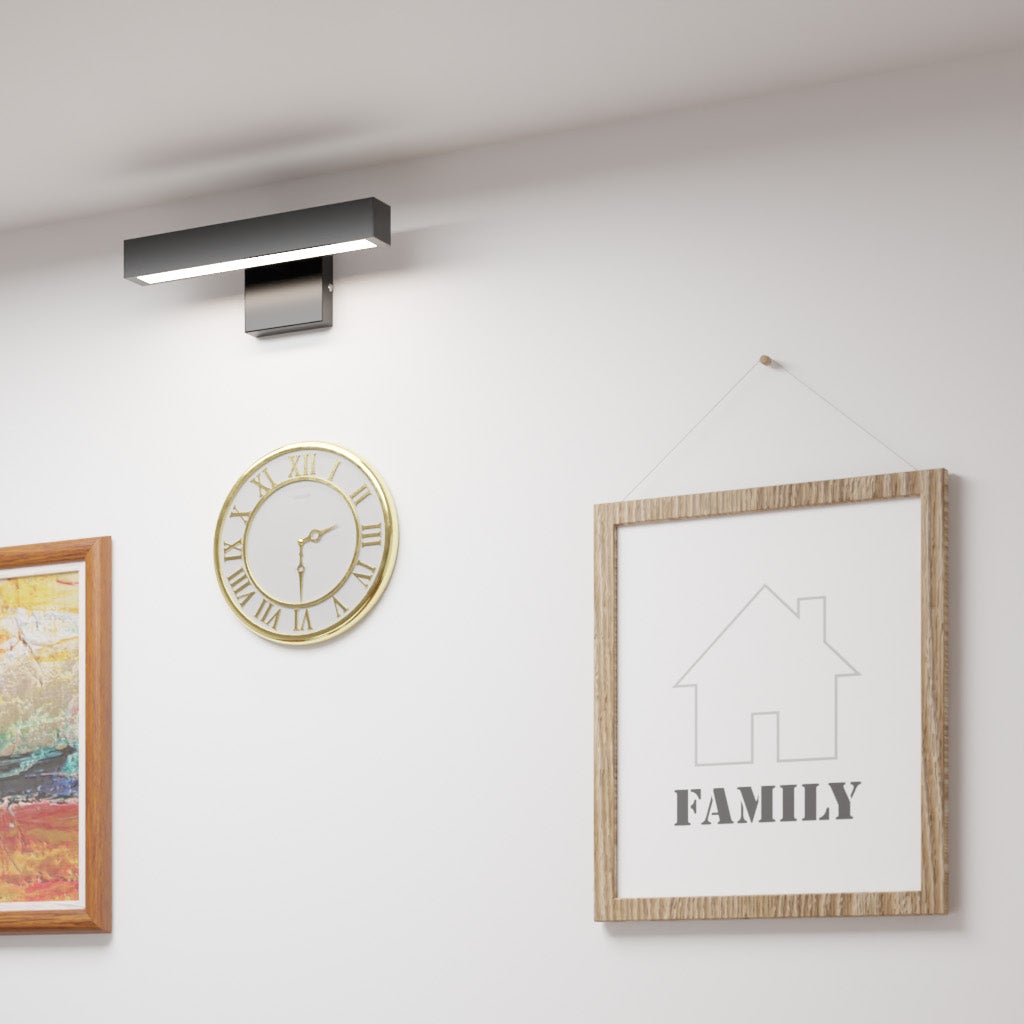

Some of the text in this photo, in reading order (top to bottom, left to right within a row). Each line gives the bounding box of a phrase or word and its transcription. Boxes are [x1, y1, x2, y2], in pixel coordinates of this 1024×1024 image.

[288, 454, 316, 478] XII
[327, 461, 340, 480] I
[250, 468, 276, 497] XI
[350, 484, 372, 505] II
[230, 505, 251, 524] X
[362, 523, 381, 548] III
[224, 540, 242, 561] IX
[353, 562, 376, 586] IV
[228, 567, 255, 606] VIII
[255, 599, 281, 630] VII
[331, 596, 349, 617] V
[293, 608, 313, 631] VI
[674, 782, 861, 826] FAMILY
